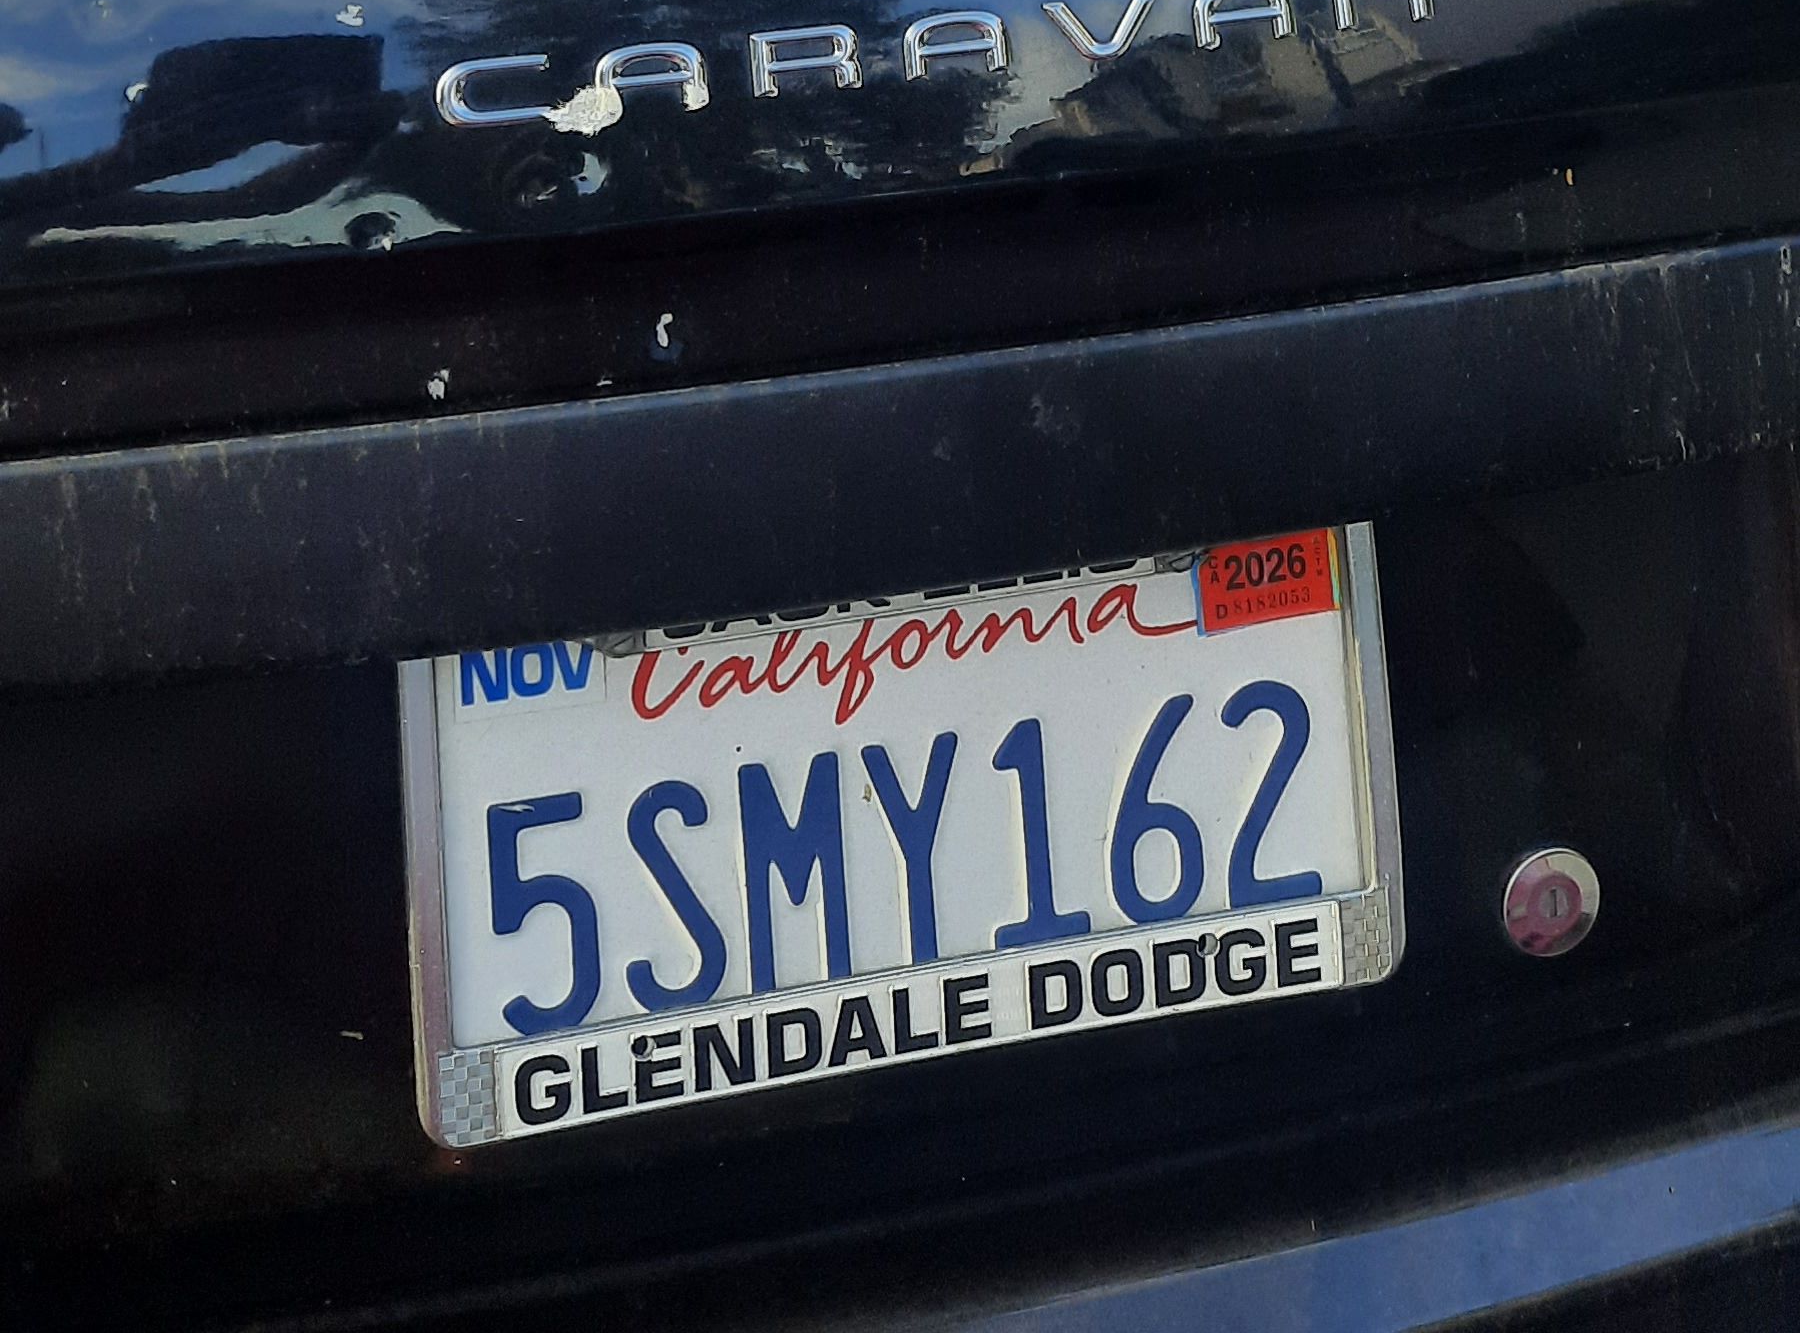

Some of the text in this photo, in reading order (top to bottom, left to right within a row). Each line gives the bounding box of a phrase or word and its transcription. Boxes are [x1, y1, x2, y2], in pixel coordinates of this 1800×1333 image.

[1224, 543, 1306, 591] 2026
[460, 640, 594, 707] NOV
[630, 582, 1197, 726] California
[485, 678, 1322, 1039] 5SMY162
[514, 919, 1322, 1128] GLENDALE DODGE
